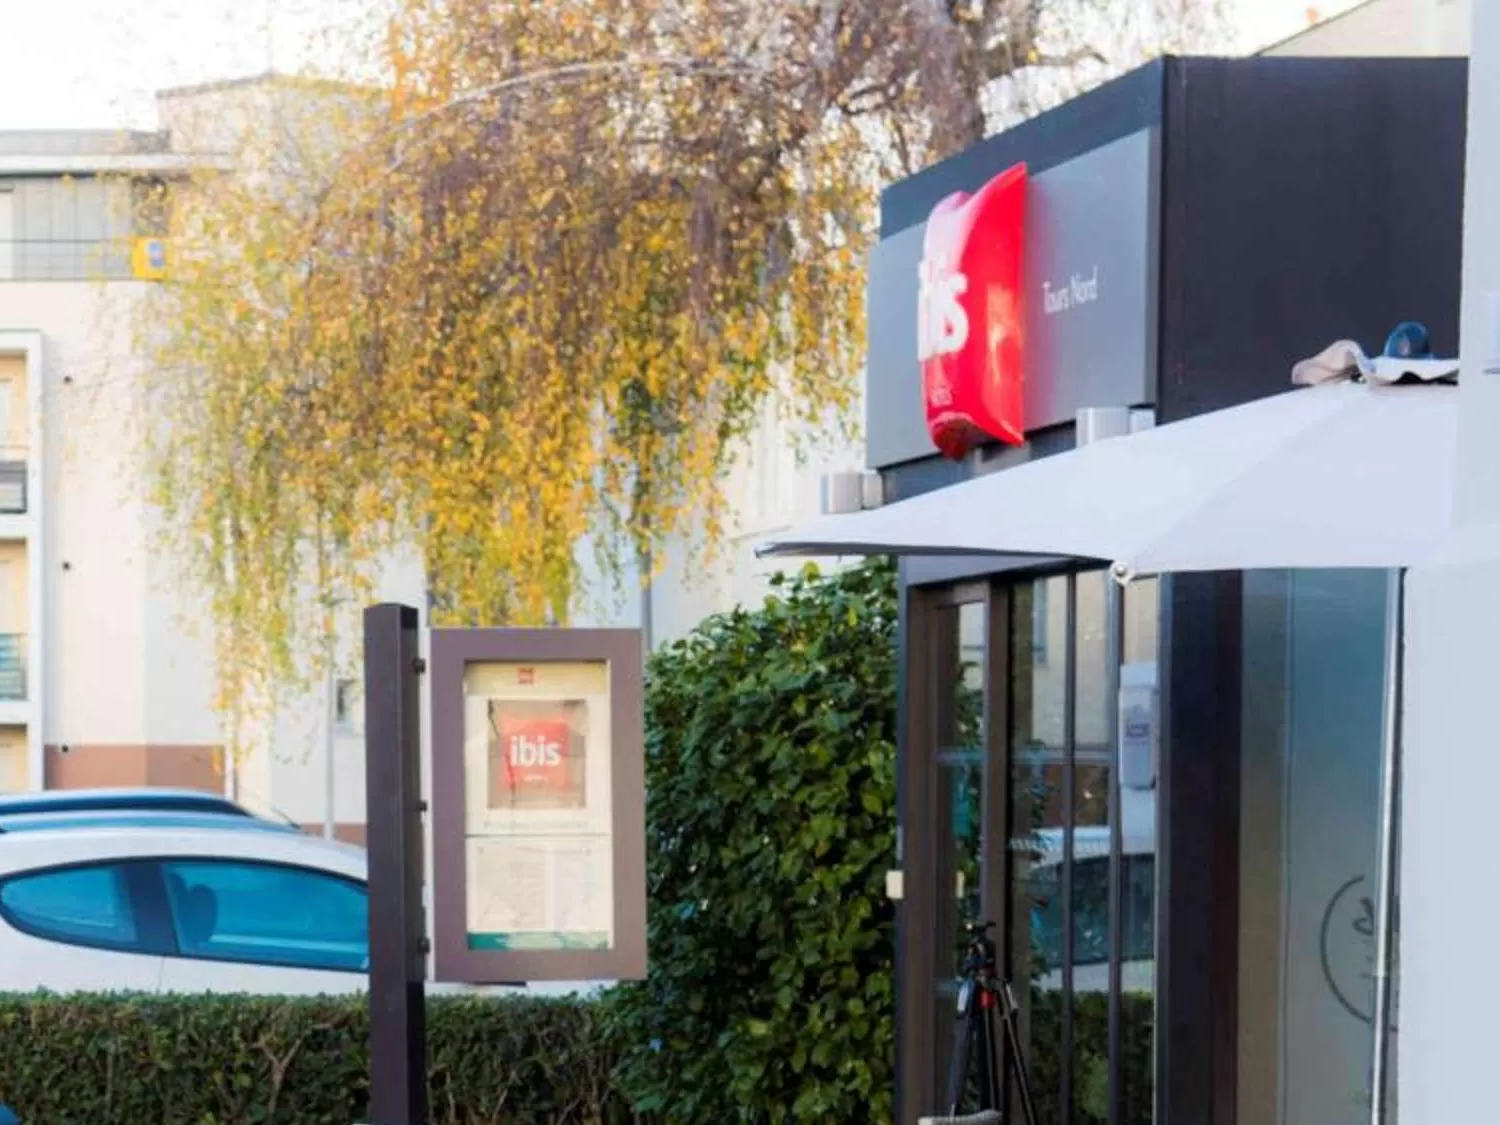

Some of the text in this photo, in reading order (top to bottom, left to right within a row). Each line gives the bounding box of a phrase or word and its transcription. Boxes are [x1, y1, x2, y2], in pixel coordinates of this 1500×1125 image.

[1042, 266, 1098, 314] Tours Nord
[510, 735, 562, 767] ibis
